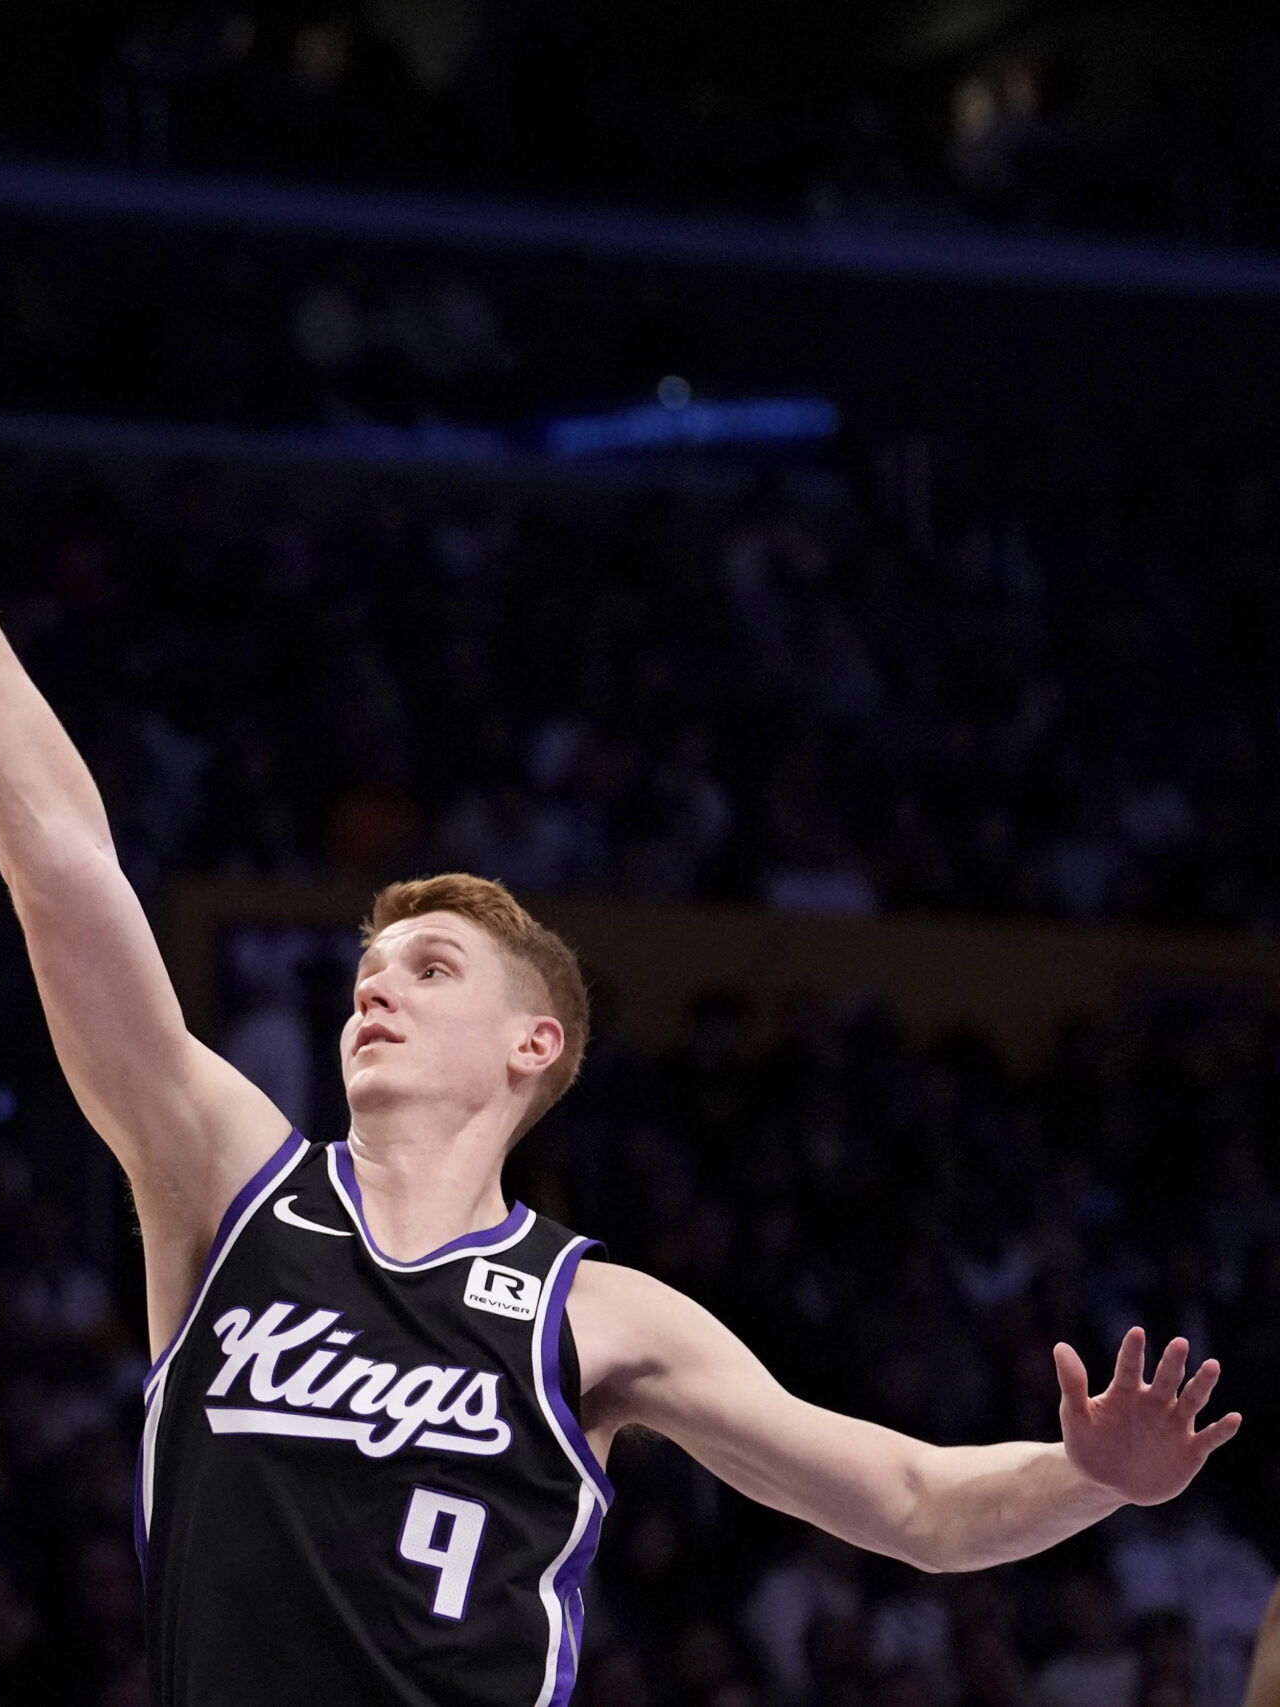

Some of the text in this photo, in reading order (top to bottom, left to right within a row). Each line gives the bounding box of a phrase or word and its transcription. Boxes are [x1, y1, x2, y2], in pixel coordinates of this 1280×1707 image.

[469, 1294, 530, 1314] REVIVER
[484, 1269, 523, 1301] R
[204, 1300, 514, 1458] Kings
[396, 1484, 489, 1622] 9
